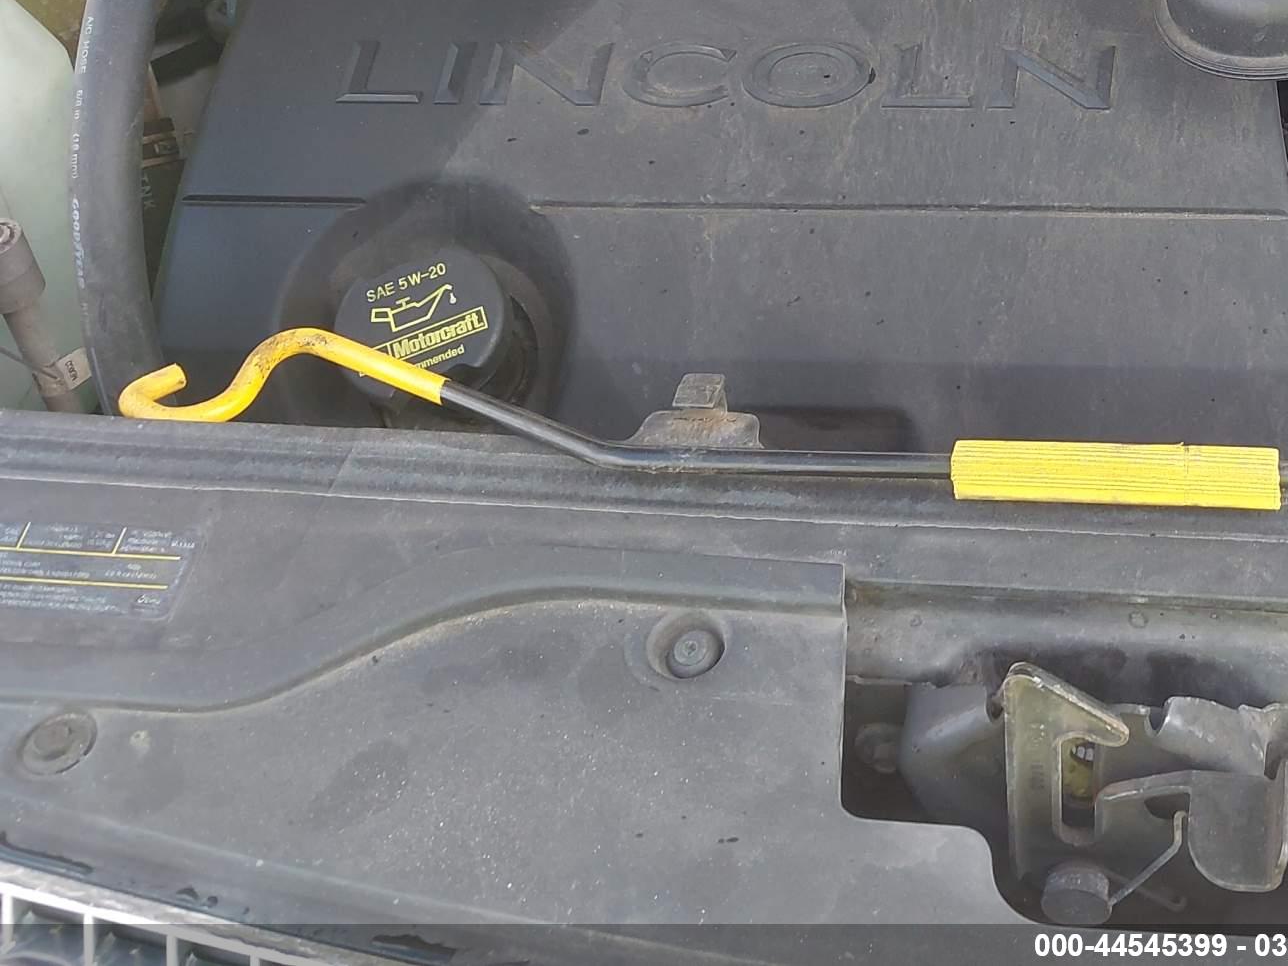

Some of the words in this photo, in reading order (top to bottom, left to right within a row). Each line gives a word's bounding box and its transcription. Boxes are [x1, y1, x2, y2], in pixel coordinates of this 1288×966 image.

[80, 40, 91, 75] HOSE
[334, 39, 1118, 112] LINCOLN
[72, 196, 86, 290] GOODYEAR
[366, 281, 396, 303] SAE
[398, 263, 447, 291] 5W-20
[416, 344, 466, 369] mmended
